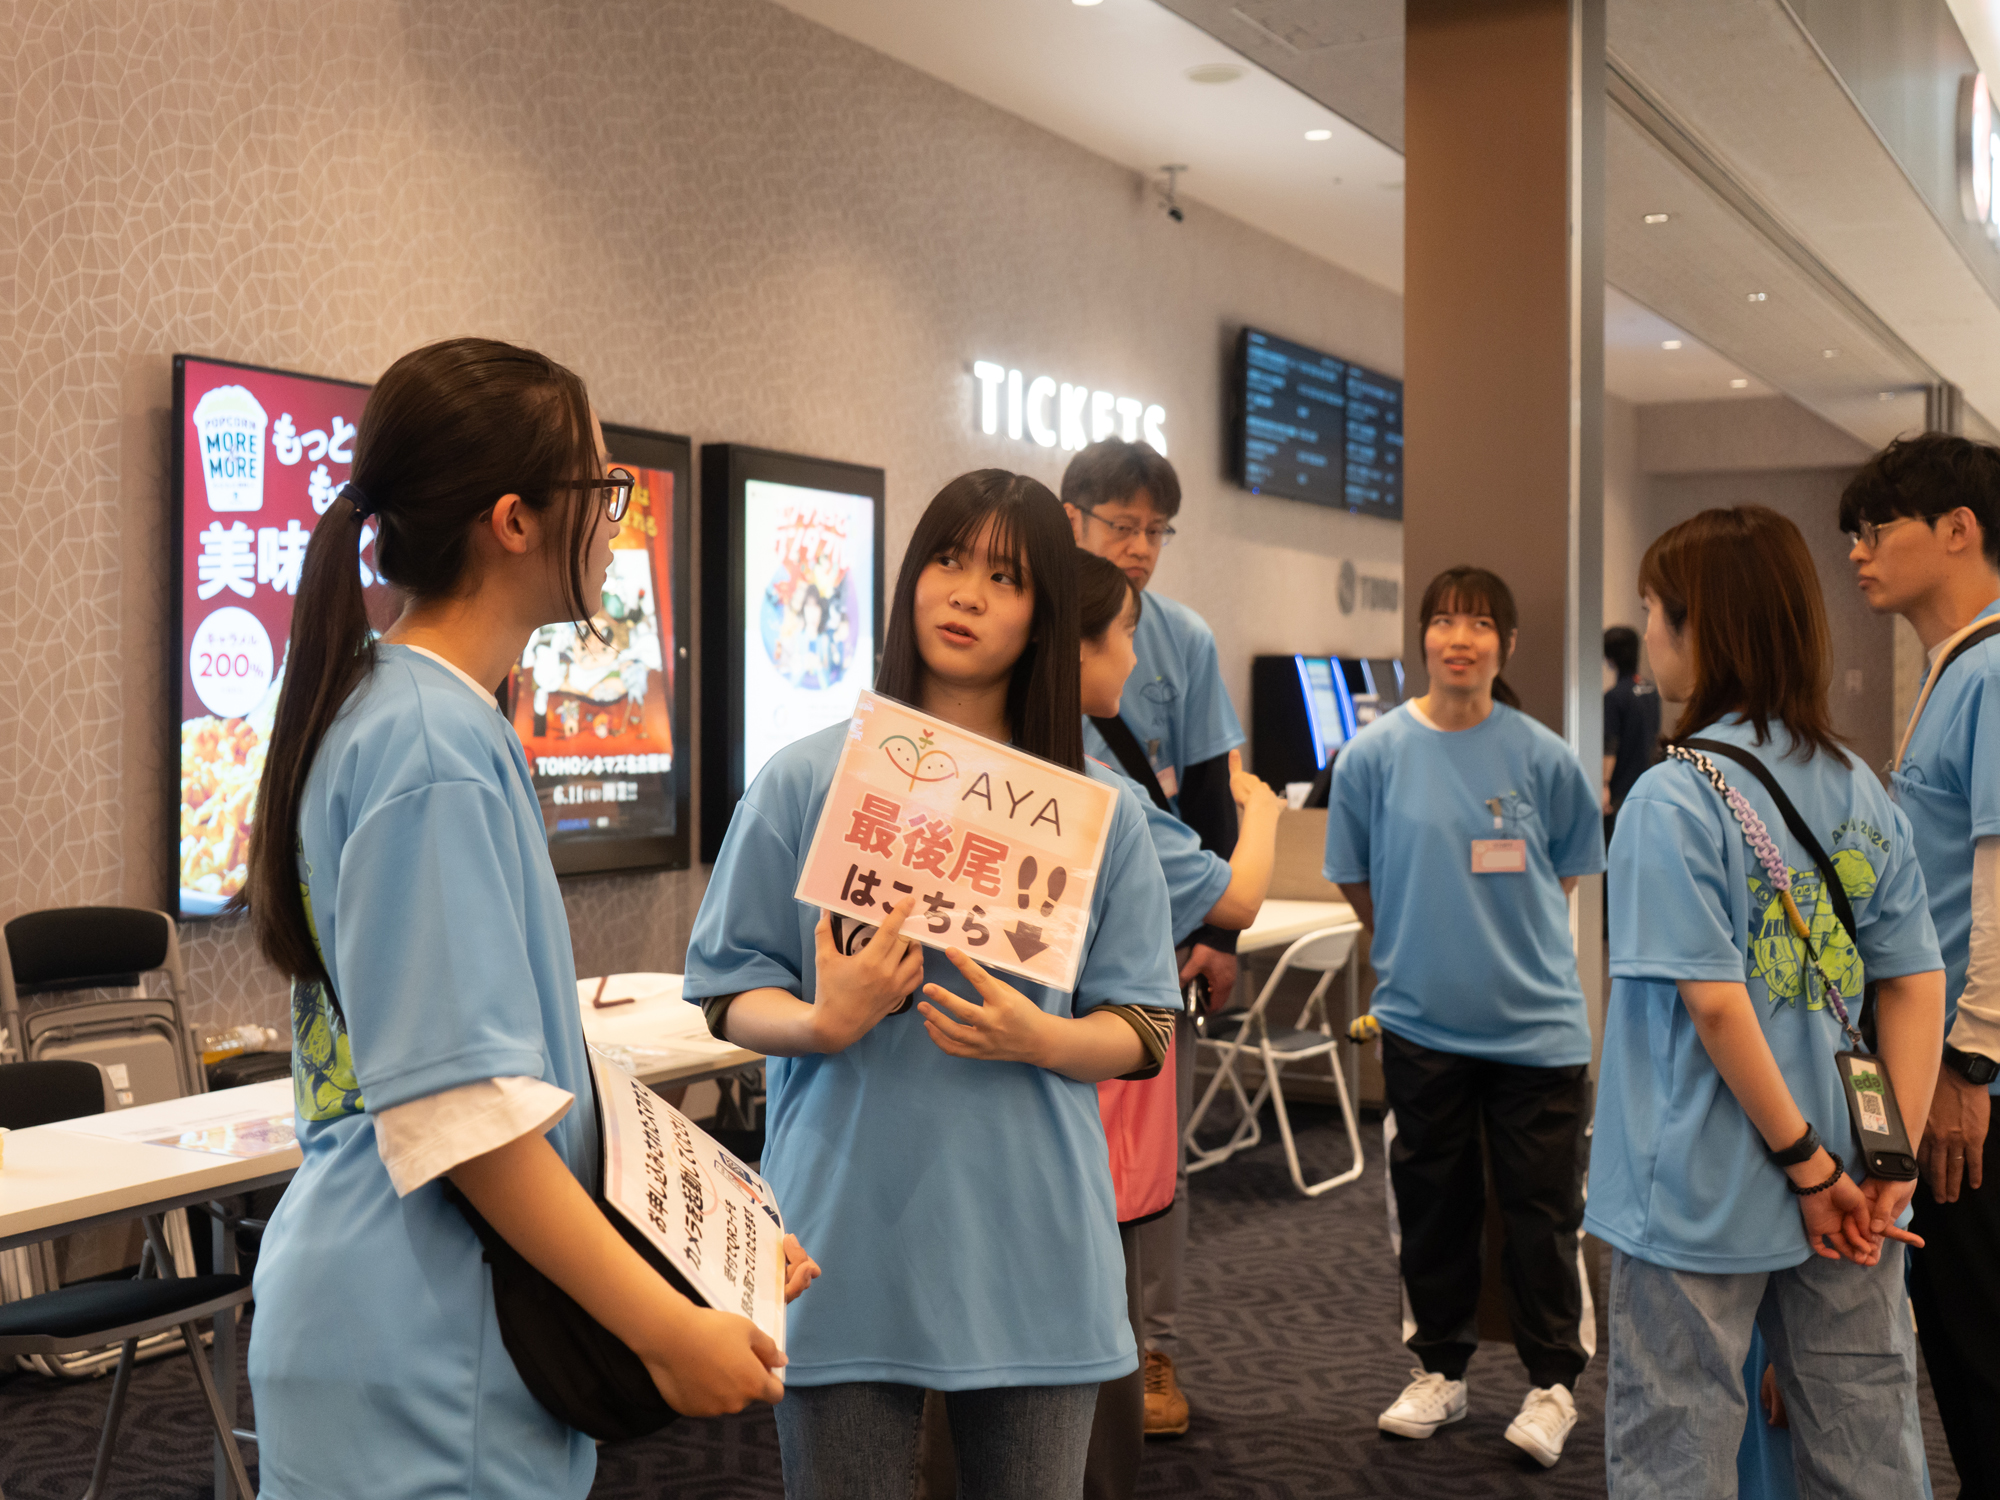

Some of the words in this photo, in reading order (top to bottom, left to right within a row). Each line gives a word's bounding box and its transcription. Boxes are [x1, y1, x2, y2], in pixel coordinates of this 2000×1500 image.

[205, 417, 257, 430] POPCORN
[206, 432, 258, 454] MORE
[272, 412, 357, 466] もっと
[974, 360, 1168, 457] TICKETS
[209, 457, 257, 478] MORE
[843, 792, 1010, 898] 最後尾
[962, 772, 1061, 837] AYA
[1860, 819, 1891, 853] 2026
[840, 864, 991, 947] はこちら
[630, 1080, 668, 1234] お申し込みされたスマホで
[667, 1110, 704, 1271] カメラを起動してください
[723, 1198, 738, 1287] 受付でQRコードを
[740, 1206, 757, 1319] 読み取っていただきます
